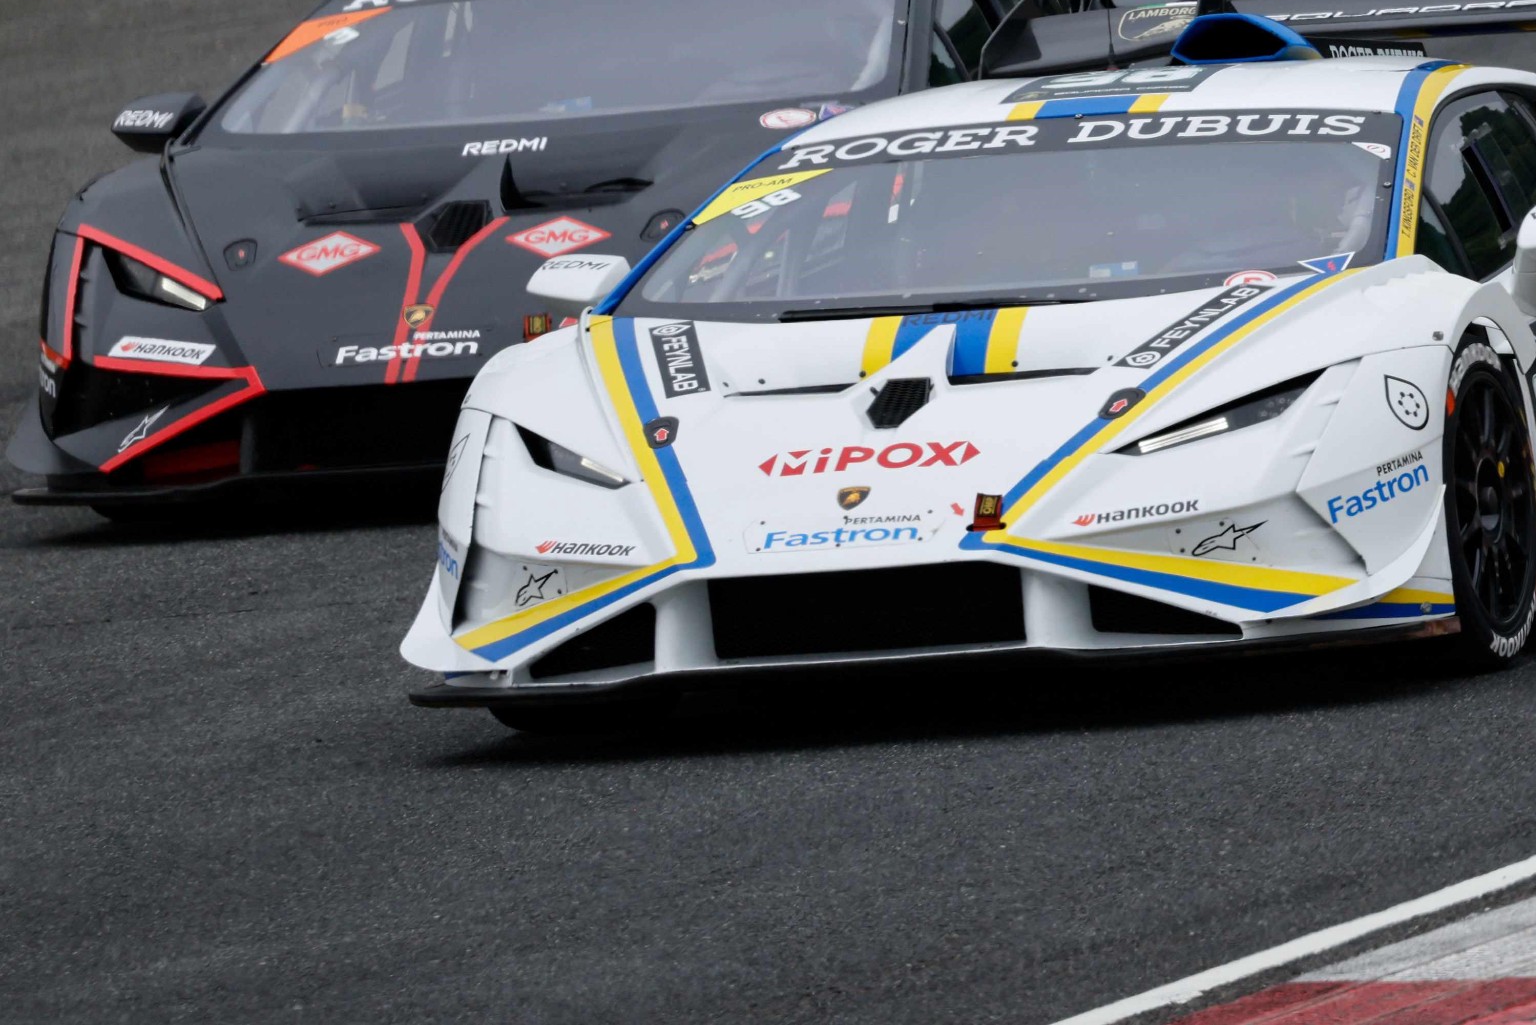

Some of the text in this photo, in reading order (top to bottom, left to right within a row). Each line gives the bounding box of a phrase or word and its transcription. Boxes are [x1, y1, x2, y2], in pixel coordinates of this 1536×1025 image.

[115, 108, 174, 128] REDMI
[462, 136, 549, 157] REDMI
[778, 114, 1366, 170] ROGER DUBUIS
[732, 177, 793, 192] PRO-AM
[730, 188, 802, 219] 98
[523, 229, 591, 245] GMG
[294, 240, 360, 264] GMG
[1150, 284, 1262, 349] FEYNLAB
[413, 329, 481, 341] PERTAMINA
[335, 341, 479, 366] Fastron
[659, 335, 700, 393] FEYNLAB
[1376, 451, 1424, 476] PERTAMINA
[1326, 463, 1430, 525] Fastron
[843, 514, 921, 526] PERTAMINA
[763, 524, 919, 550] Fastron
